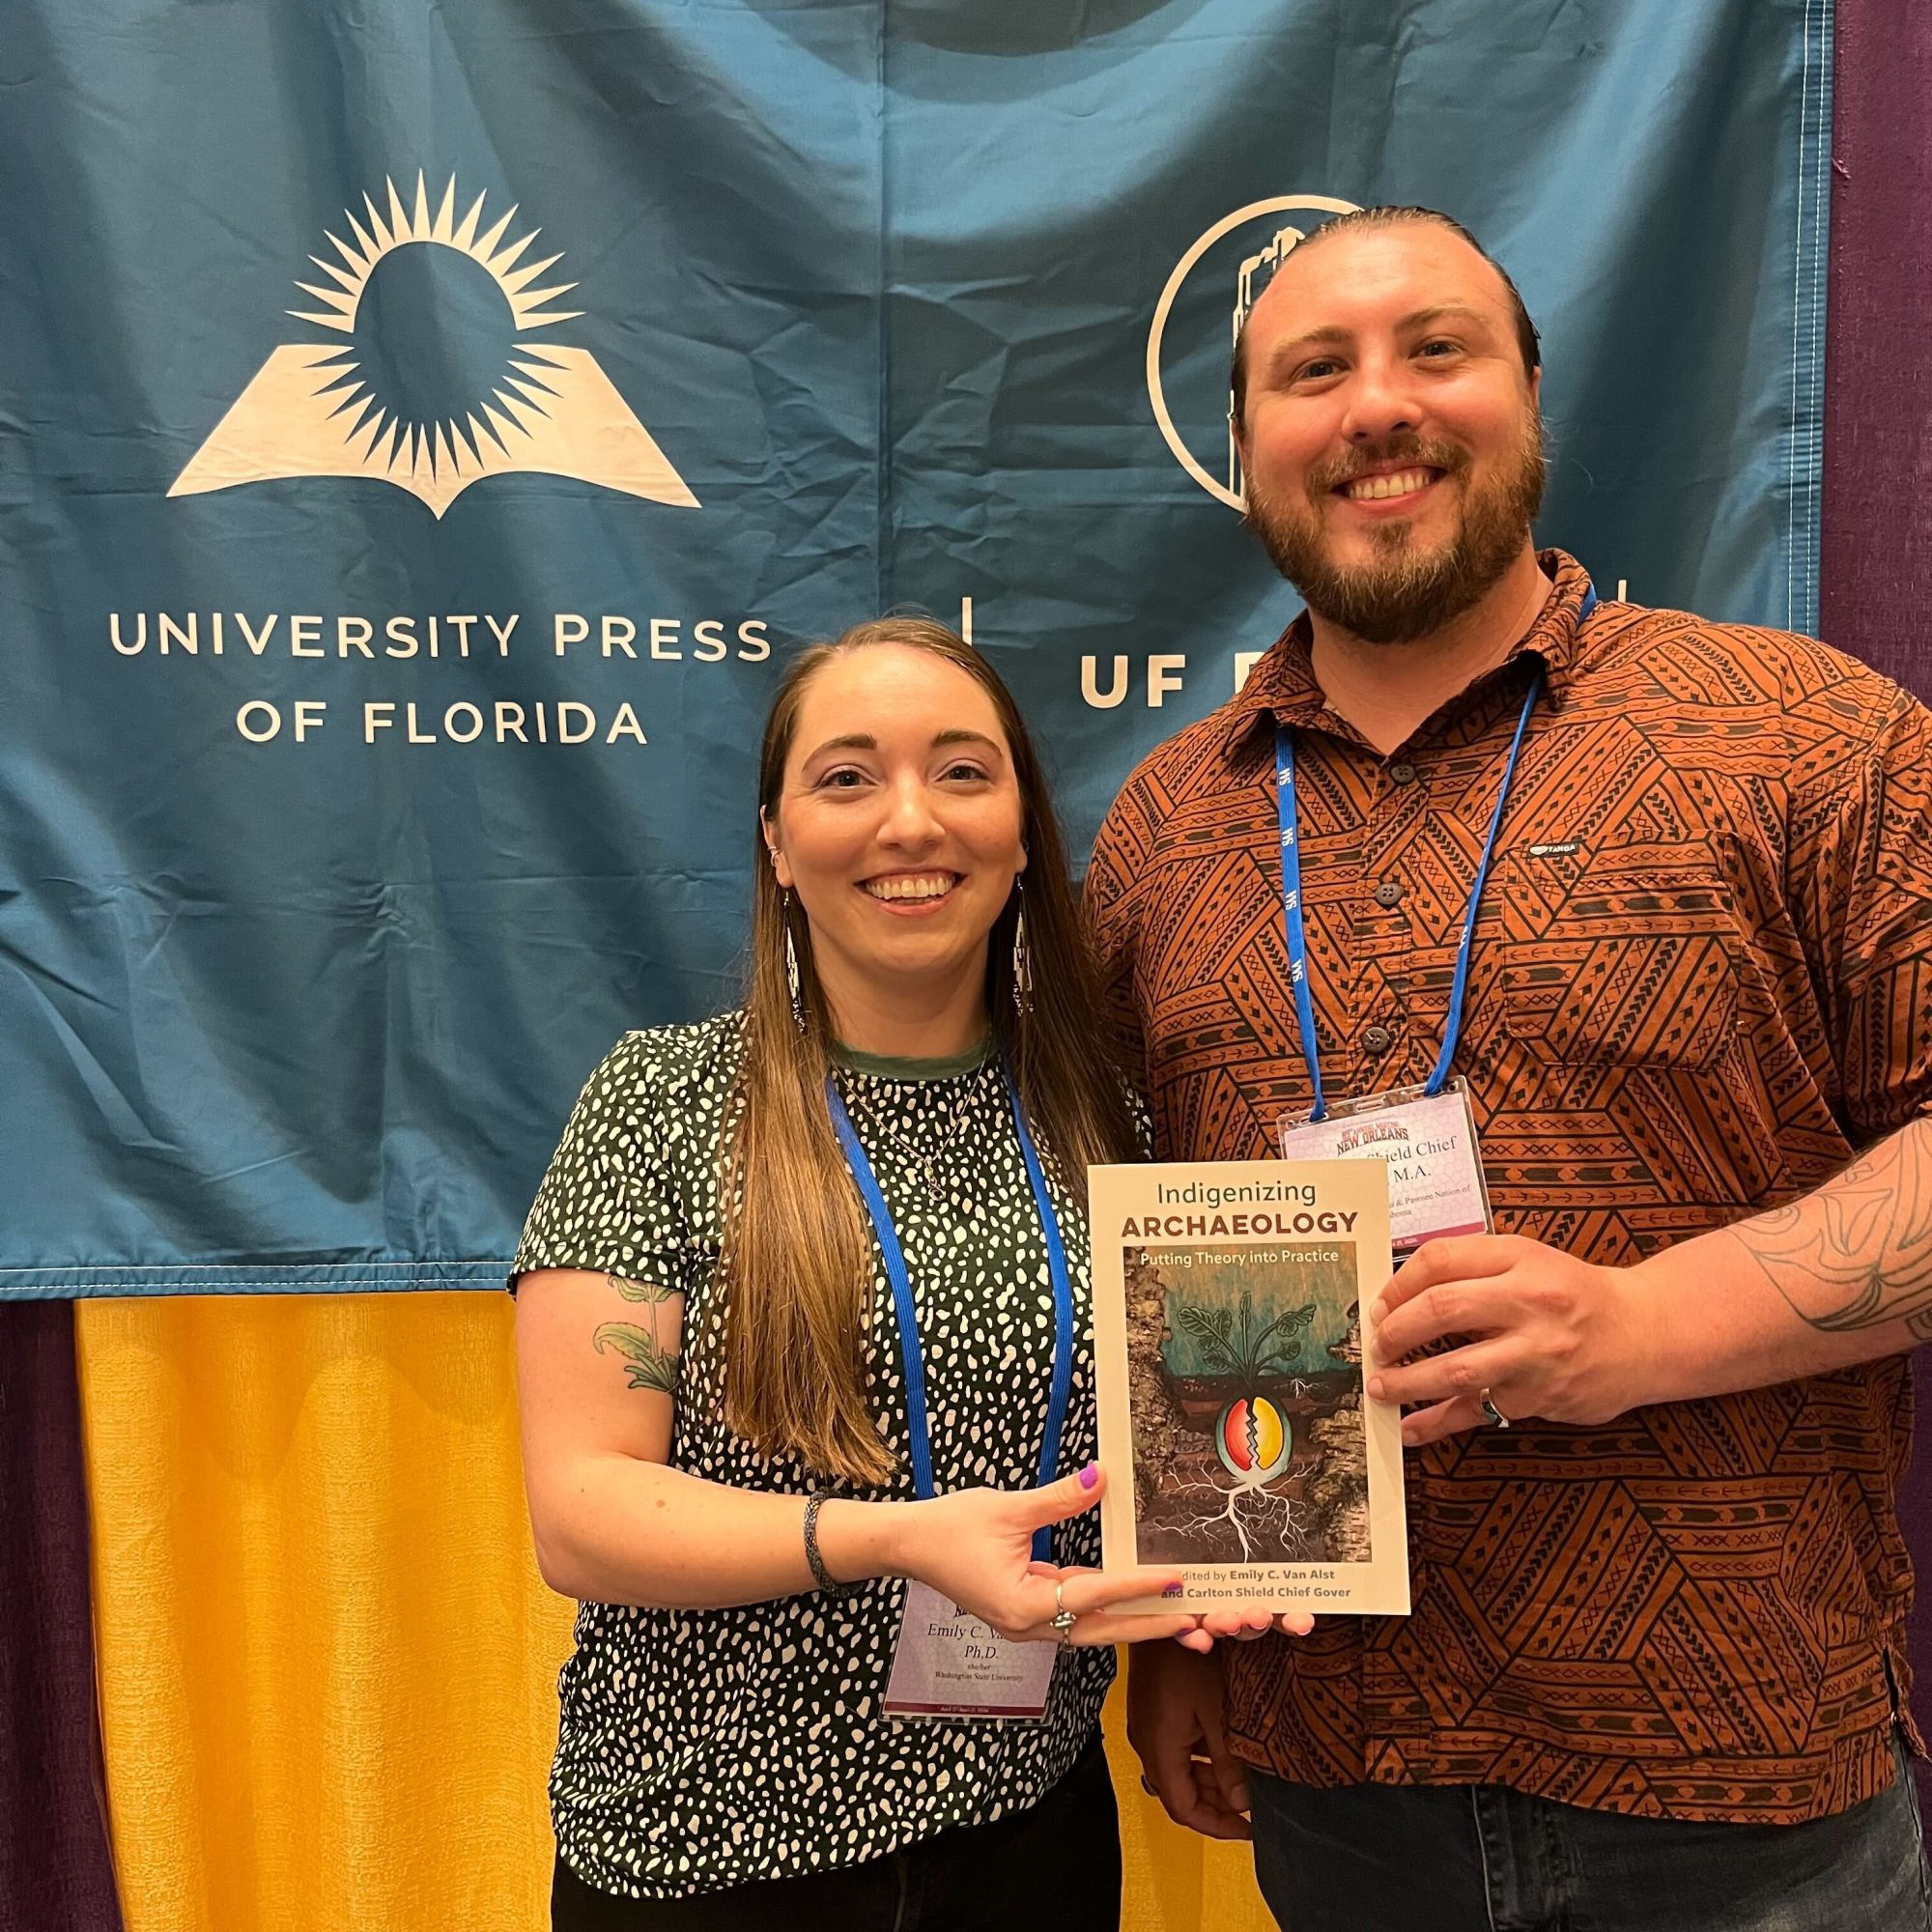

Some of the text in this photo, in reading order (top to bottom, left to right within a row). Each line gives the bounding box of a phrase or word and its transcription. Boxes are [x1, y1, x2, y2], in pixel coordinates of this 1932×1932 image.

[109, 612, 772, 663] UNIVERSITY PRESS
[1079, 654, 1187, 709] UF
[236, 700, 648, 746] OF FLORIDA
[1337, 1128, 1409, 1156] NEW ORLEANS
[1416, 1136, 1458, 1155] Chief
[1393, 1166, 1431, 1183] M.A.
[1158, 1180, 1317, 1208] Indigenizing
[1406, 1194, 1434, 1205] Pawnee
[1435, 1188, 1462, 1199] Nation
[1122, 1211, 1359, 1238] ARCHAEOLOGY
[1141, 1249, 1339, 1268] Putting Theory into Practice
[1182, 1569, 1335, 1583] dited by Emily C. Van Alst
[1187, 1587, 1233, 1598] Carlton
[1236, 1586, 1274, 1598] Shield
[1277, 1586, 1310, 1598] Chief
[1314, 1587, 1351, 1598] Gover
[927, 1623, 966, 1640] Emily
[970, 1626, 984, 1638] C.
[965, 1645, 999, 1660] Ph.D.
[935, 1671, 972, 1682] Washington
[992, 1673, 1023, 1683] University
